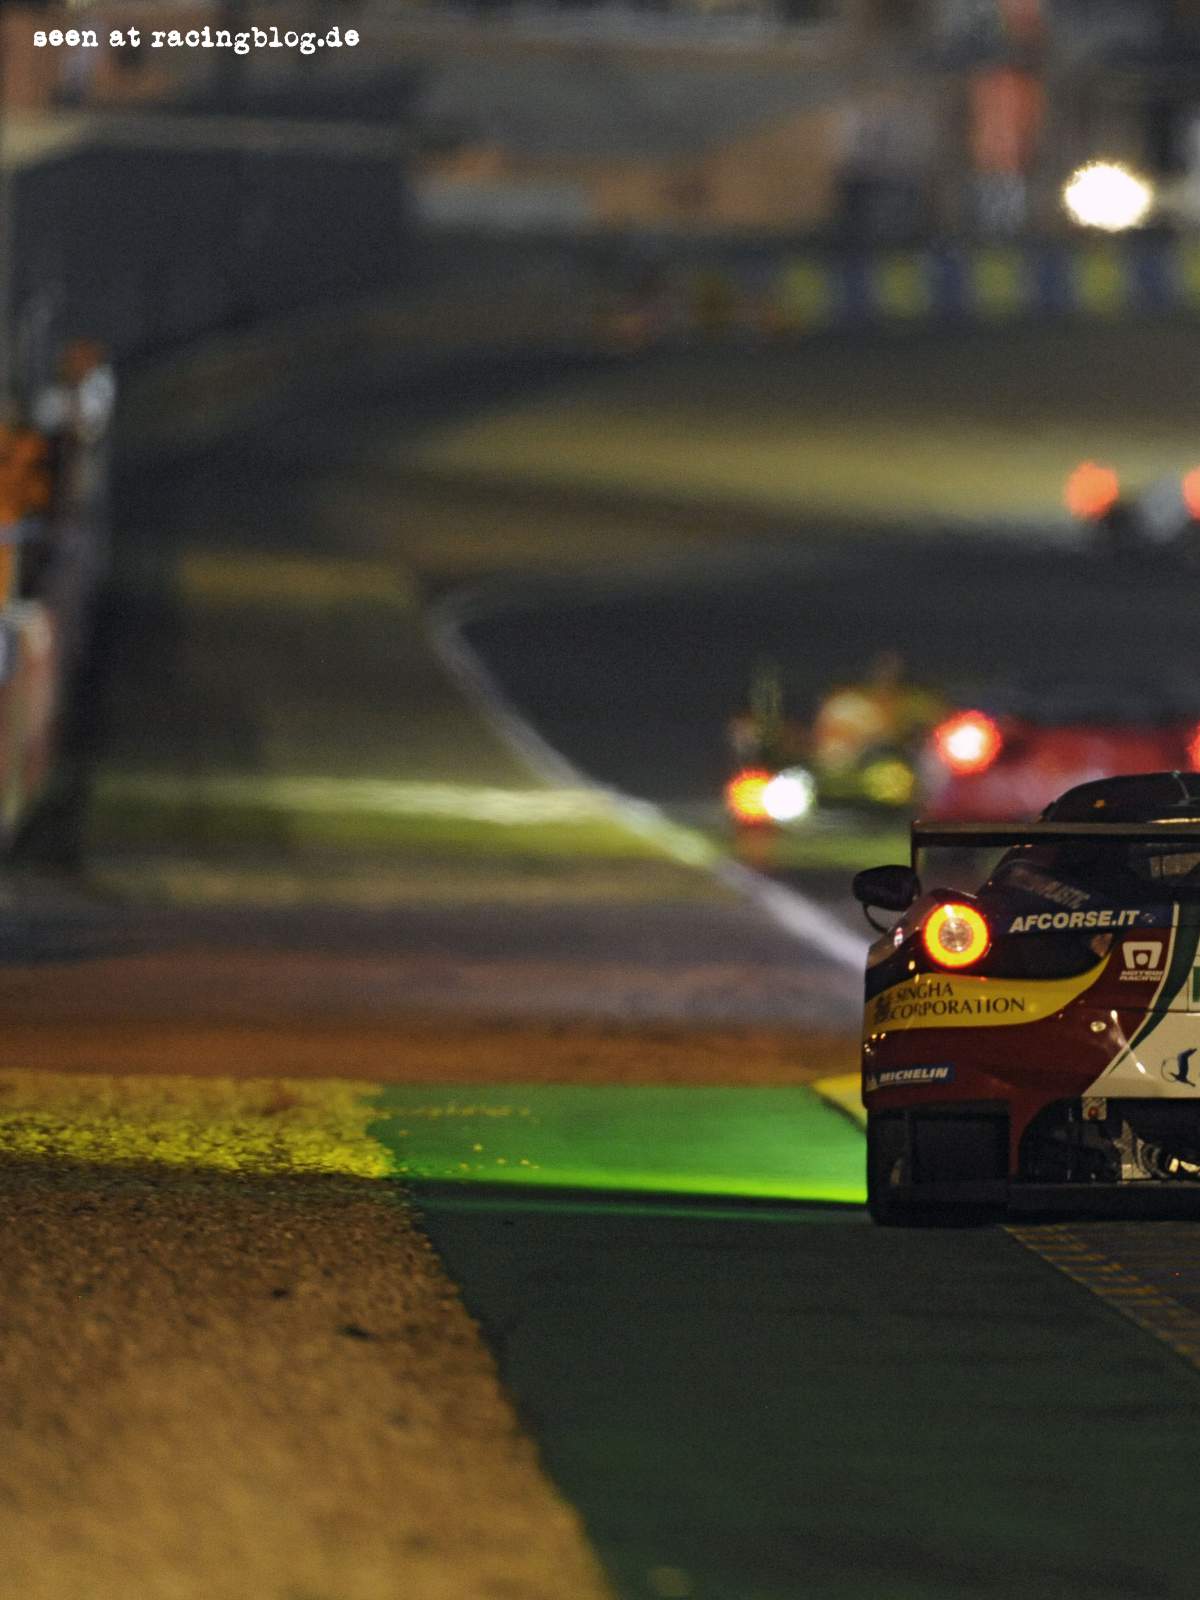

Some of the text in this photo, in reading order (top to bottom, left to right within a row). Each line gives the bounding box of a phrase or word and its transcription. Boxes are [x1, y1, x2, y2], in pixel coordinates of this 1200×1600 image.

[1009, 910, 1140, 934] AFCORSE.IT
[890, 997, 1026, 1020] CORPORATION
[879, 1067, 949, 1083] MICHELIN
